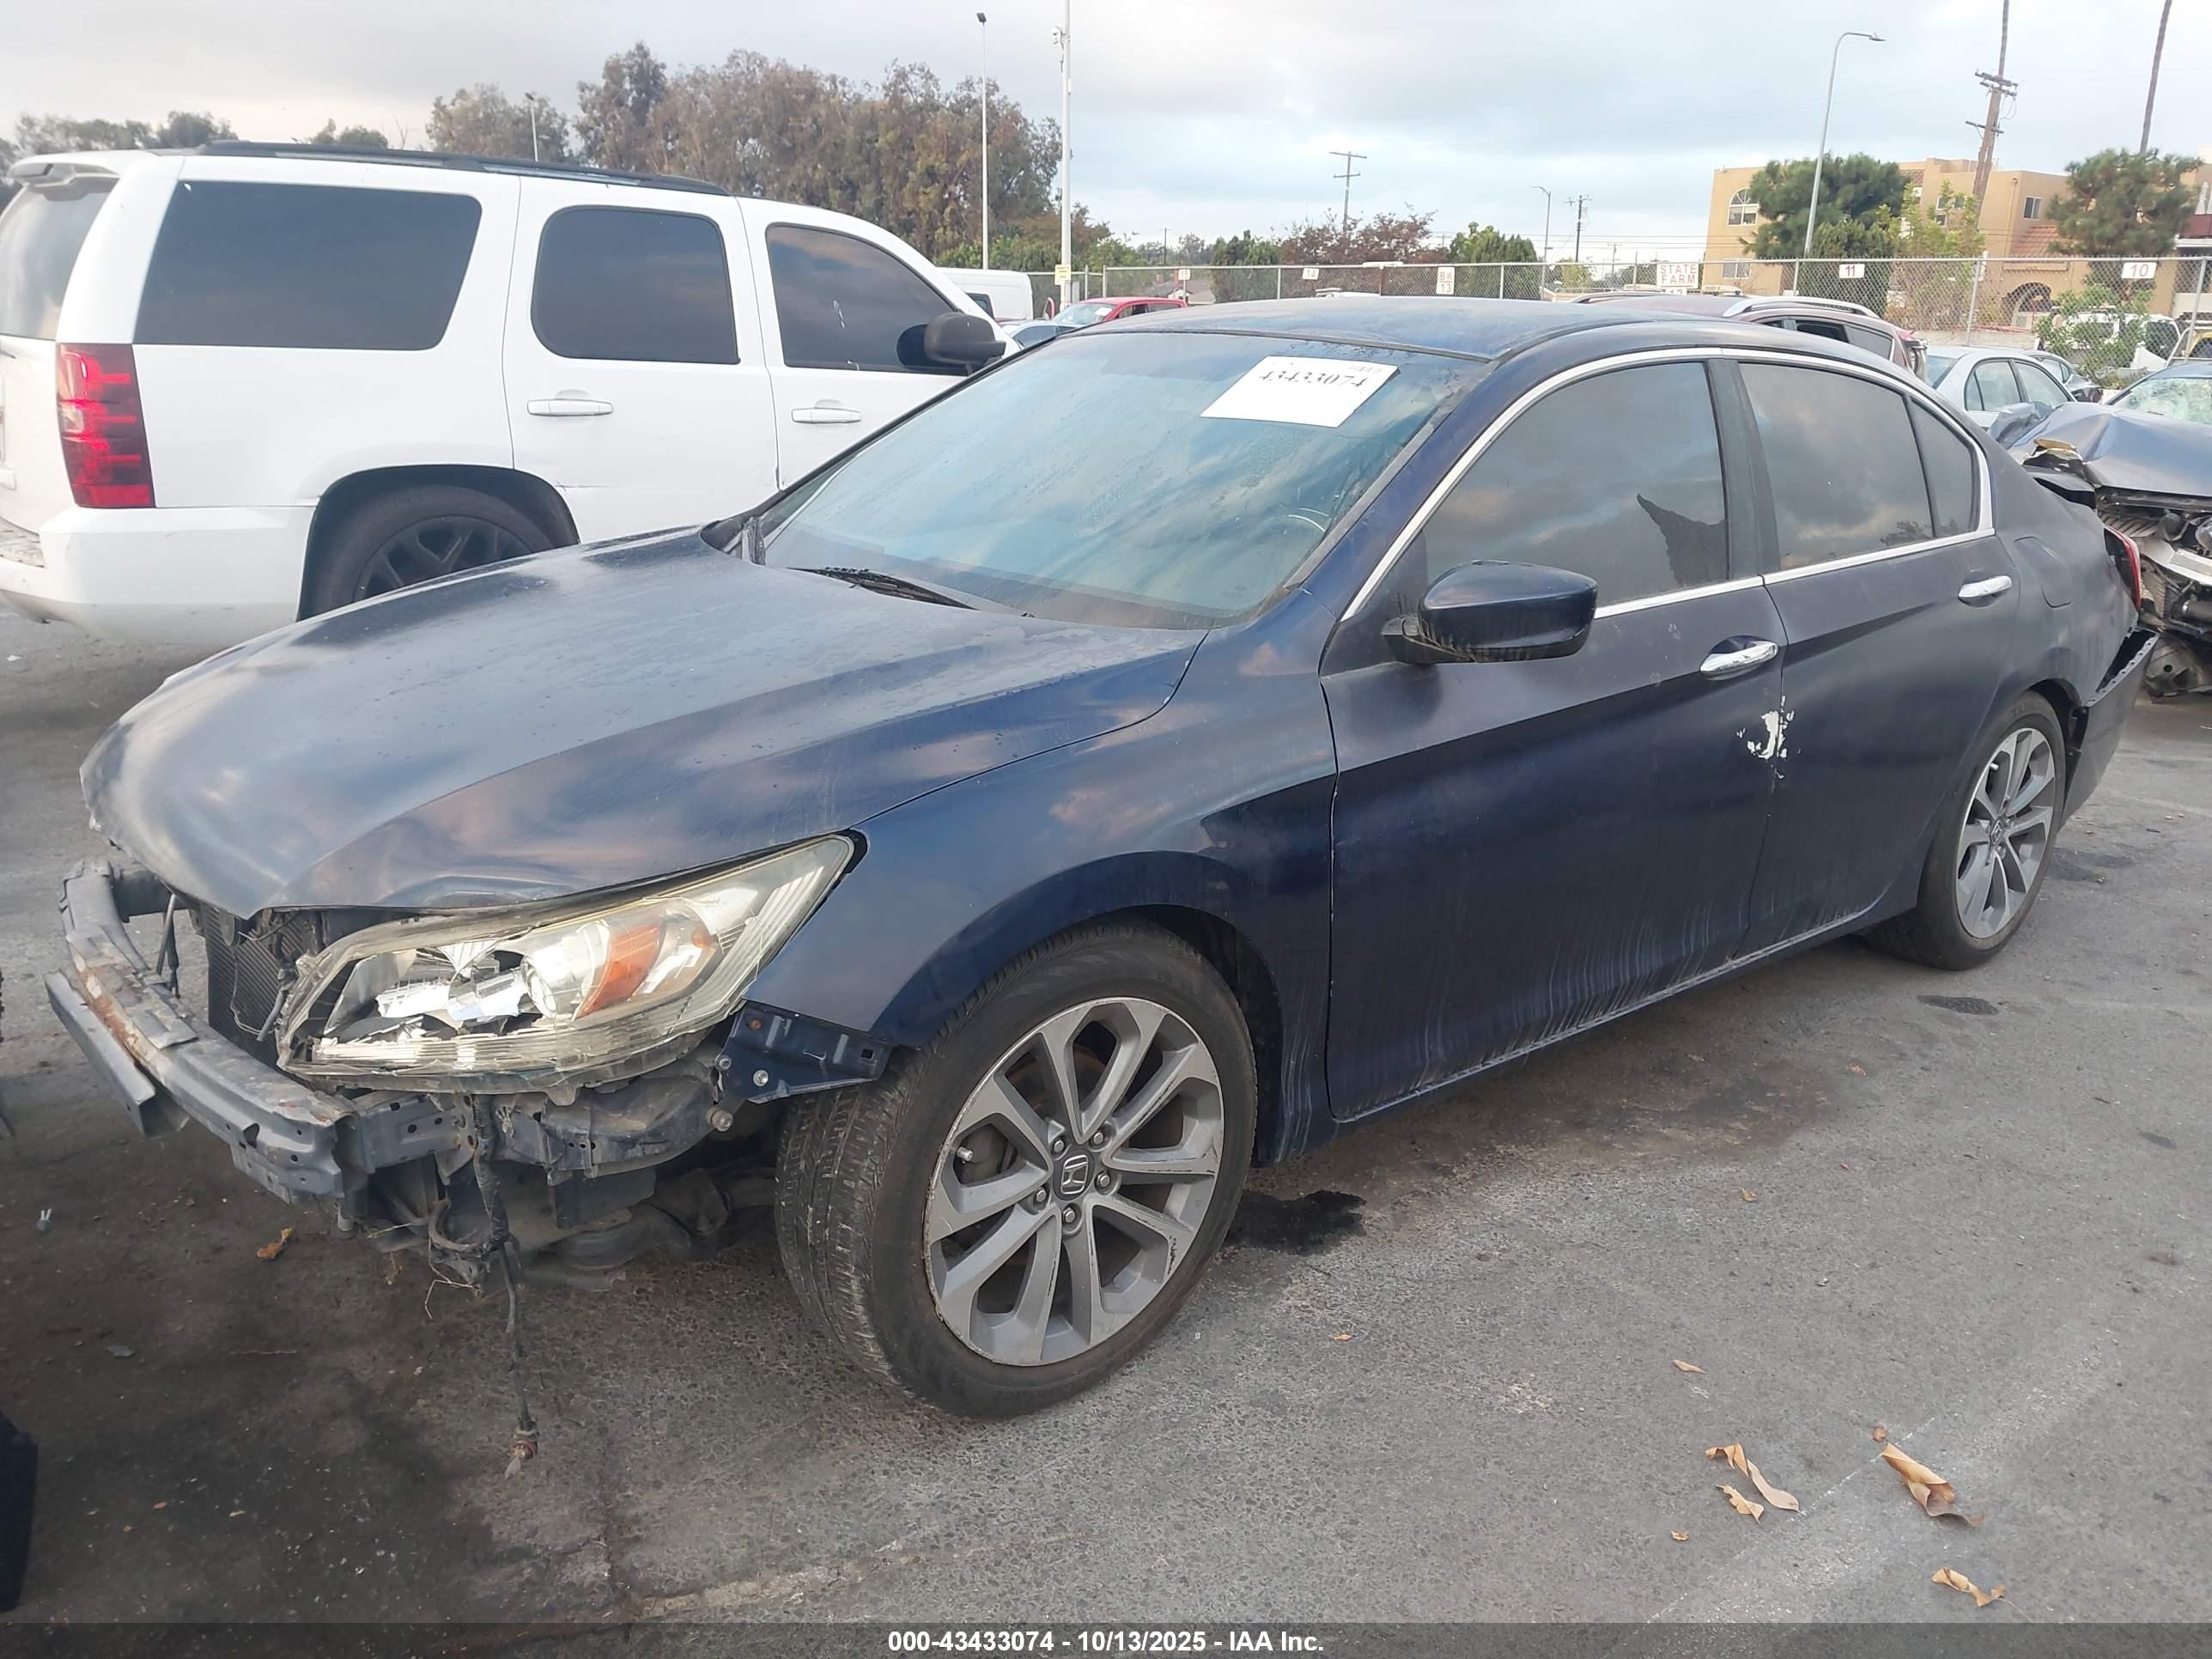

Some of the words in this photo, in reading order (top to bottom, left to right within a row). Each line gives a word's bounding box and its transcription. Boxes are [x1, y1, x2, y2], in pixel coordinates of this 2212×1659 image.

[1661, 264, 1697, 275] STATE
[1845, 264, 1856, 276] 11
[2130, 264, 2149, 277] 10
[1662, 275, 1695, 284] FARM
[1441, 283, 1451, 293] 13
[1258, 370, 1369, 387] 43433074
